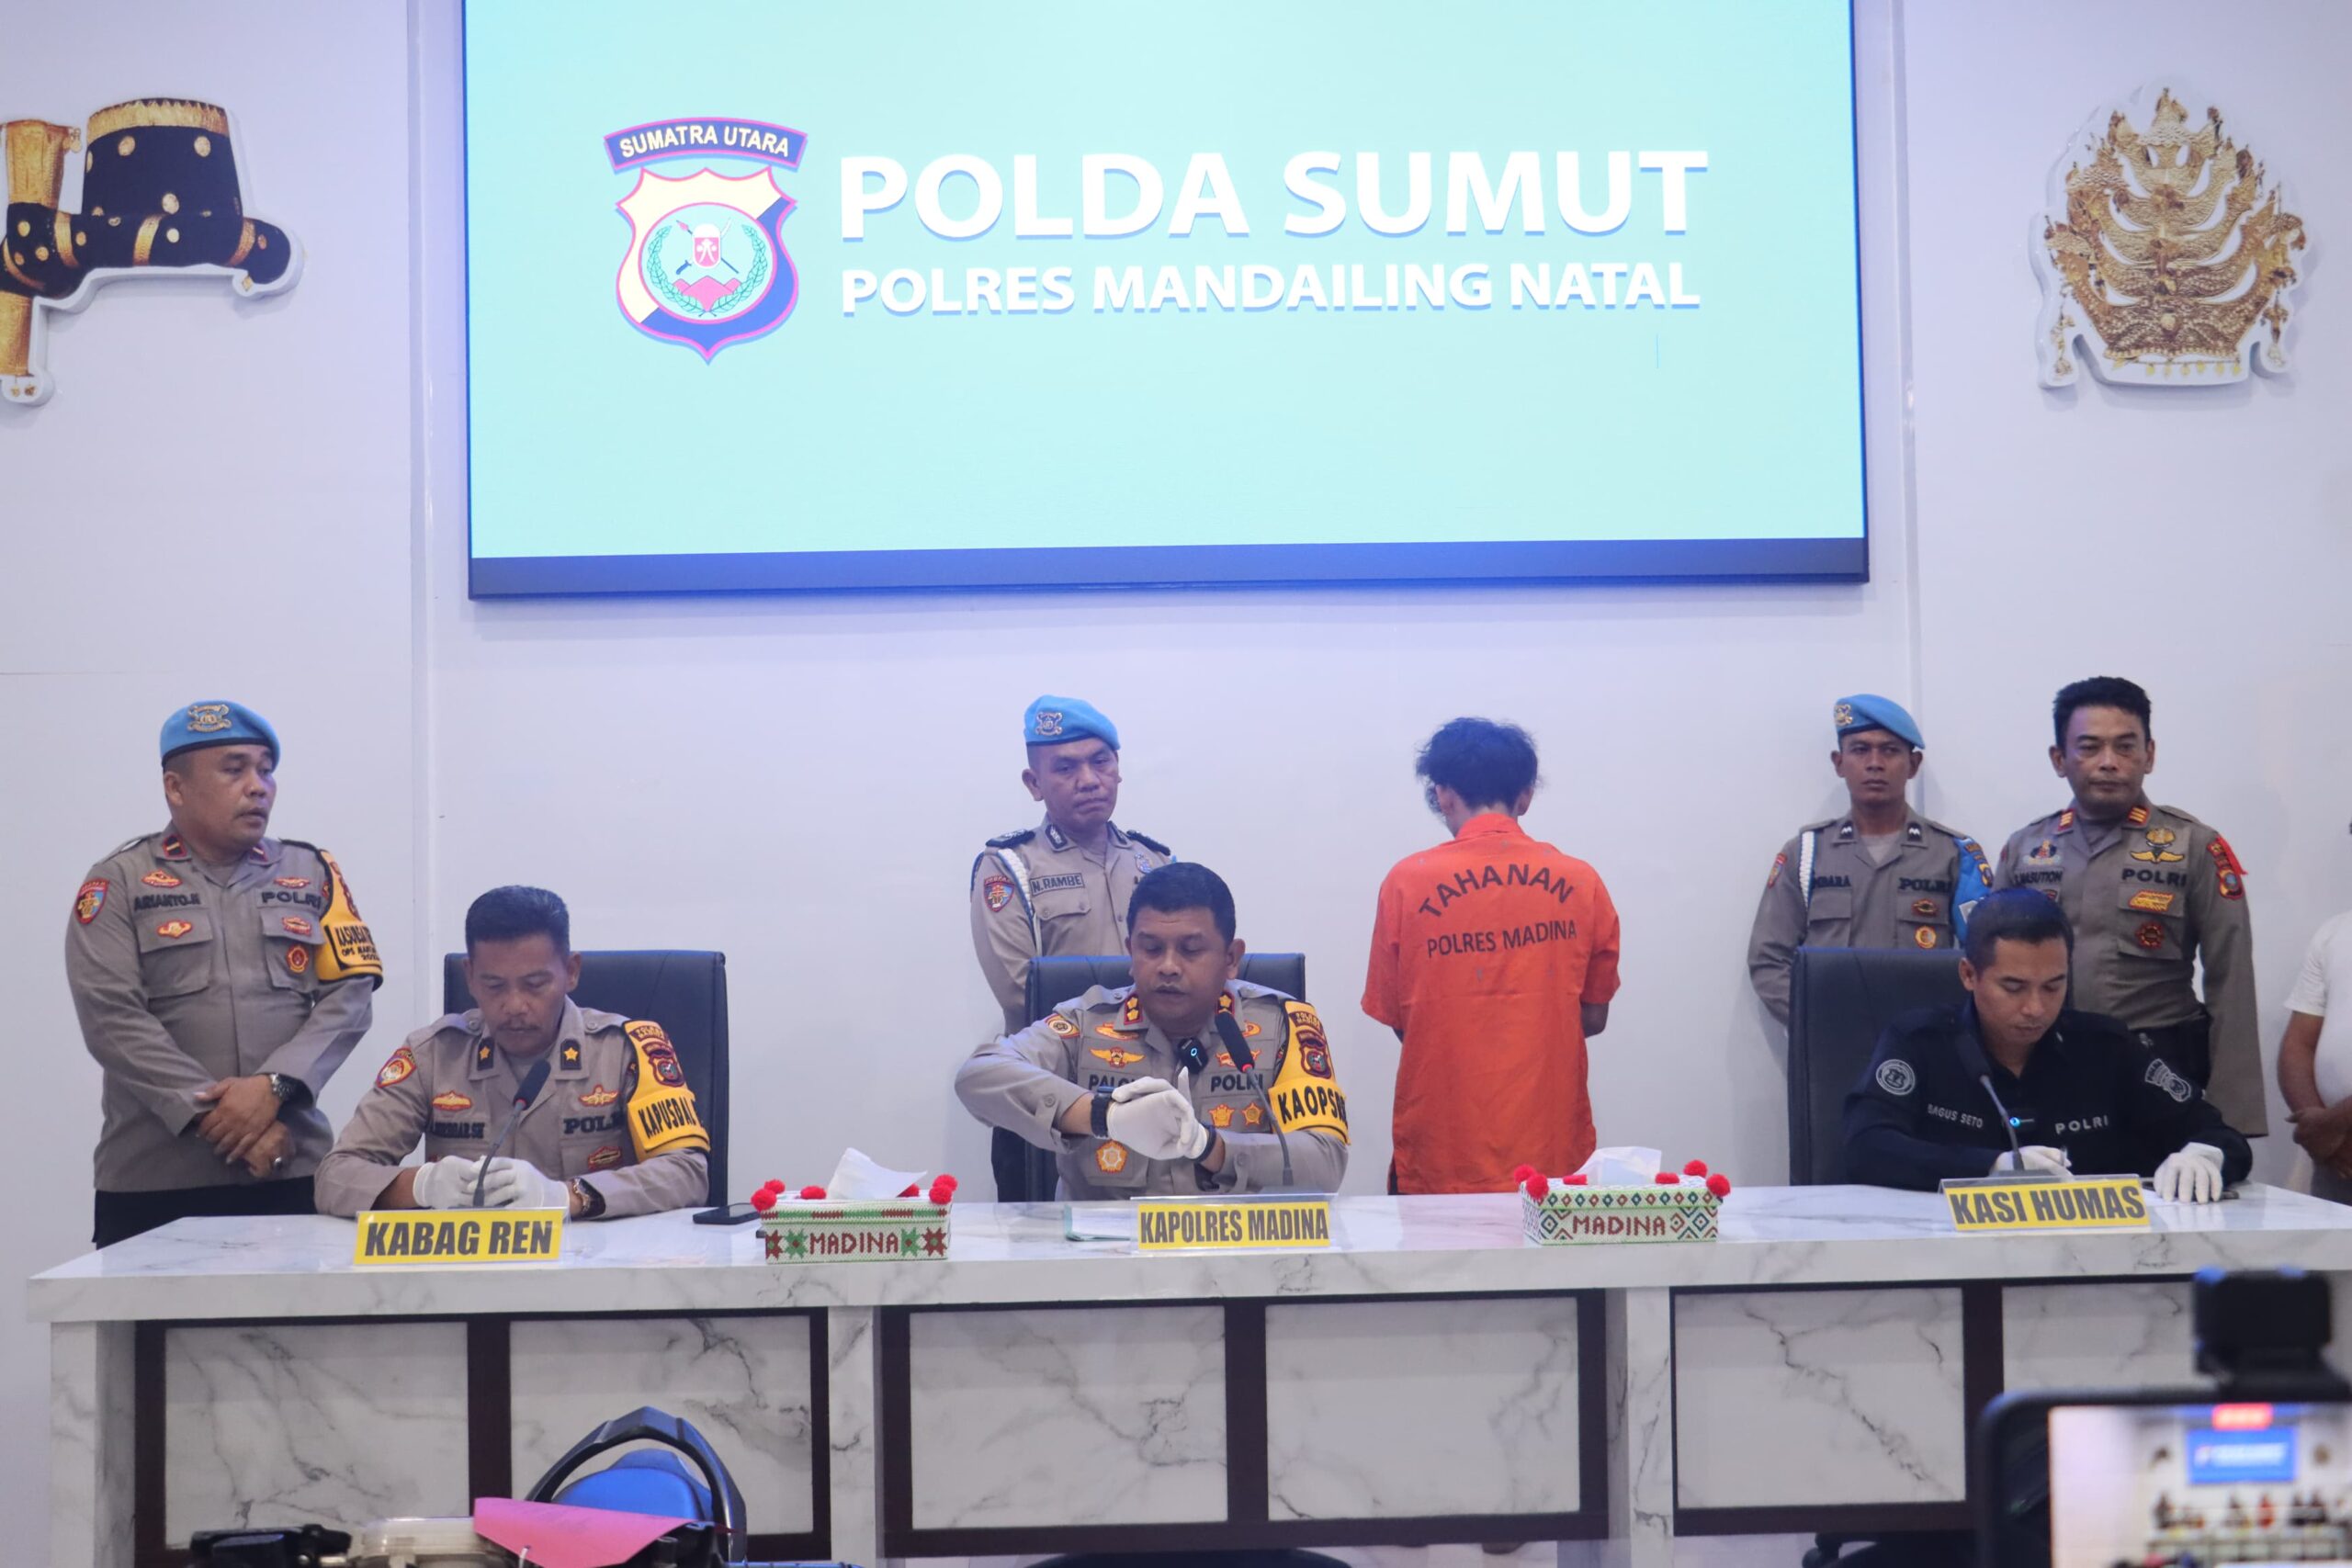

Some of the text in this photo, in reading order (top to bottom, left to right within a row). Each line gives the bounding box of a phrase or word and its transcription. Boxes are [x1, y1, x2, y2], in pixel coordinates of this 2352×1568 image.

[619, 125, 789, 158] SUMATRA UTARA
[841, 151, 1708, 240] POLDA SUMUT
[842, 262, 1700, 315] POLRES MANDAILING NATAL
[1032, 874, 1081, 893] N.RAMBE
[1419, 863, 1575, 918] TAHANAN
[1898, 877, 1953, 894] POLRI
[2121, 868, 2187, 887] POLRI
[262, 891, 322, 910] POLRI
[1427, 919, 1577, 958] POLRES MADINA
[1928, 1103, 1984, 1129] BAGUS SETO
[2054, 1114, 2109, 1135] POLRI
[1950, 1185, 2146, 1224] KASI HUMAS
[365, 1220, 553, 1257] KABAG REN
[1140, 1208, 1329, 1244] KAPOLRES MADINA
[1572, 1215, 1667, 1235] MADINA
[809, 1232, 899, 1255] MADINA
